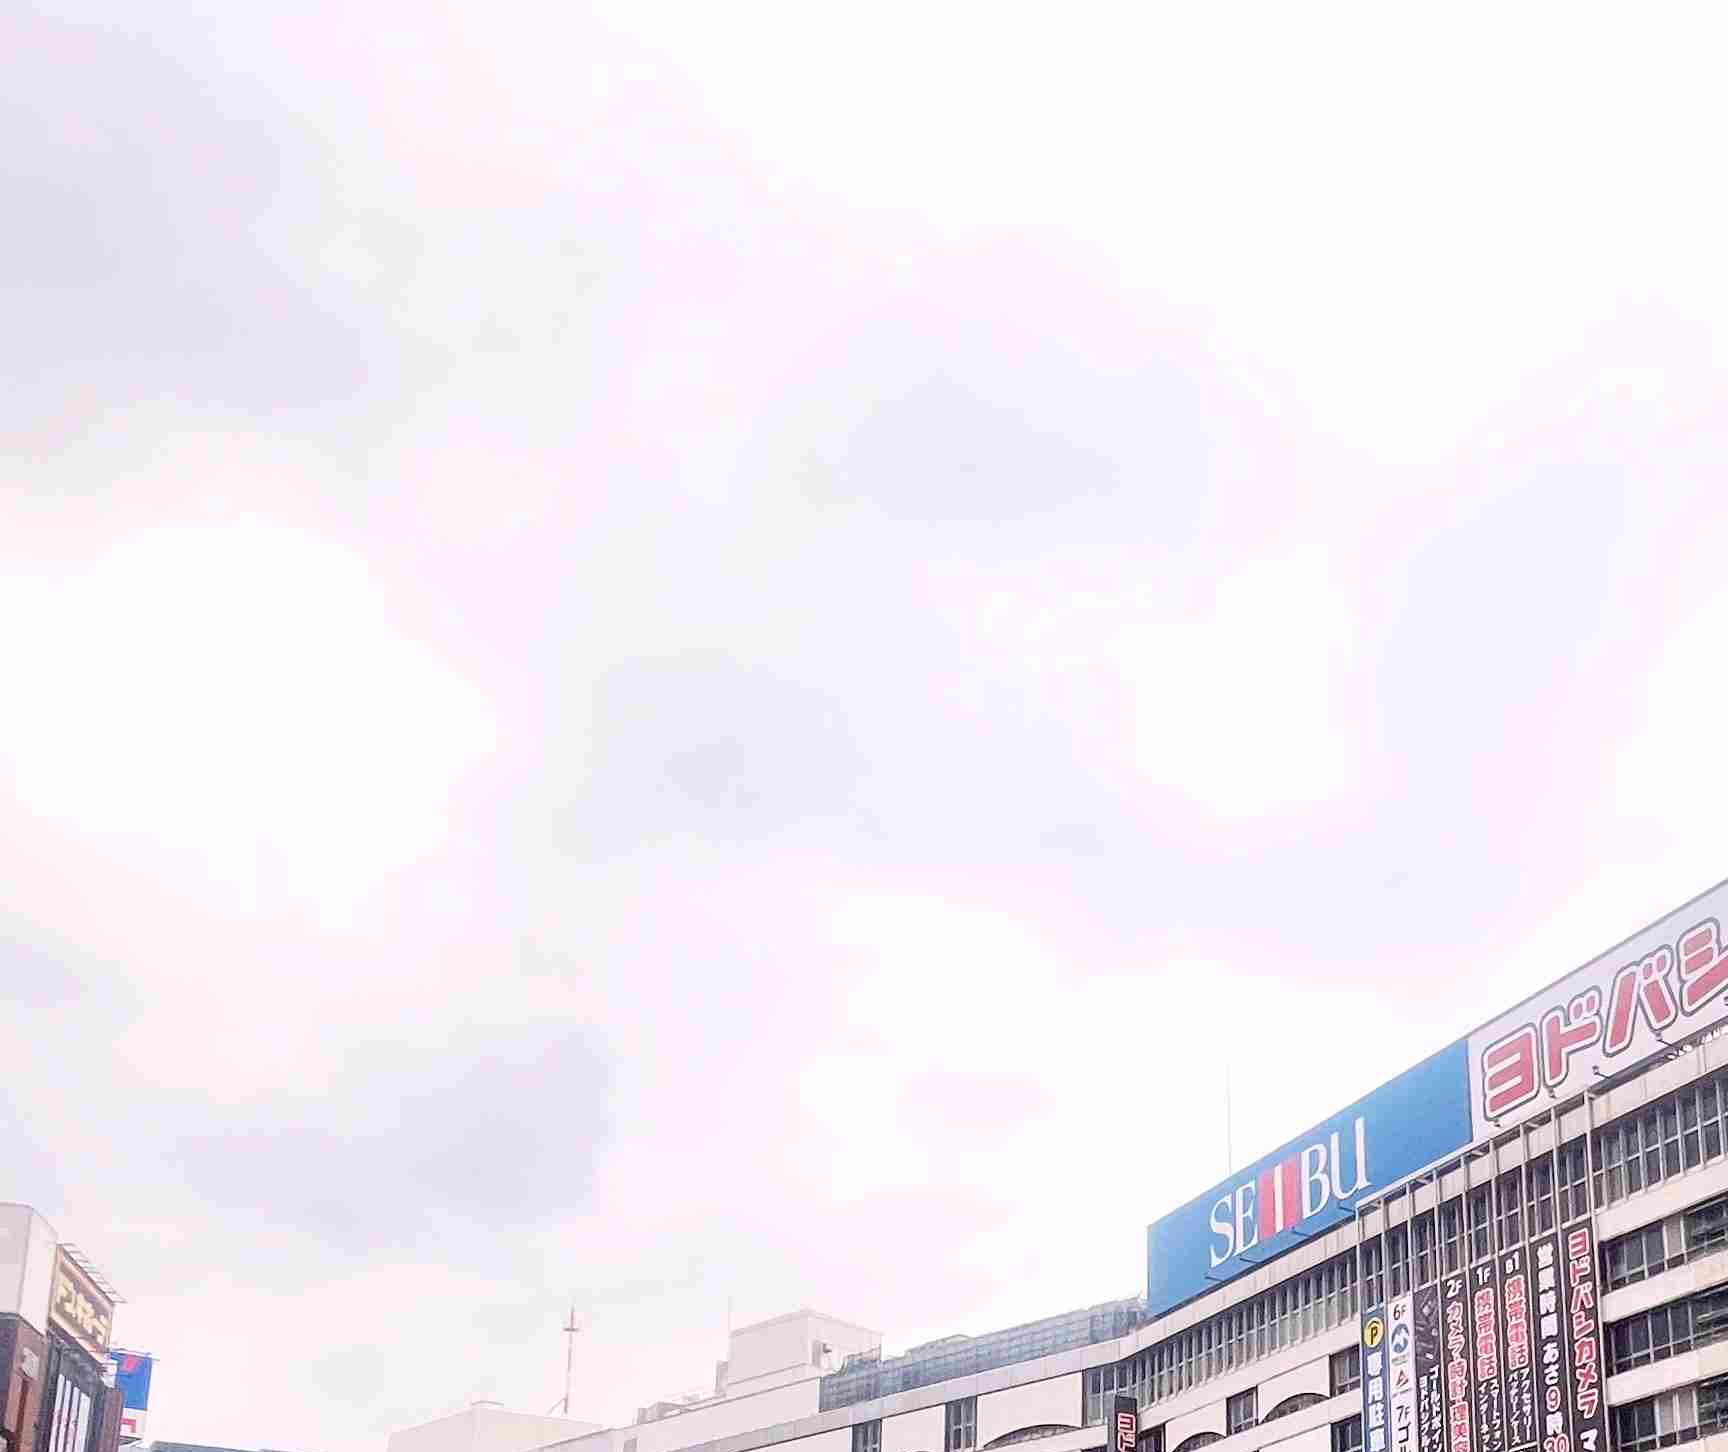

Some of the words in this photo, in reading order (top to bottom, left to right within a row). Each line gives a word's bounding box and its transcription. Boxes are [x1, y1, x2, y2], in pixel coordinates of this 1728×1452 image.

[1209, 1115, 1371, 1268] SEIBU
[1505, 1251, 1520, 1274] B1
[1476, 1266, 1491, 1286] 1F
[1446, 1280, 1463, 1299] 2F
[1393, 1304, 1407, 1321] 6F
[1567, 1227, 1599, 1419] ヨドバシカメラ
[1396, 1404, 1411, 1423] 7F
